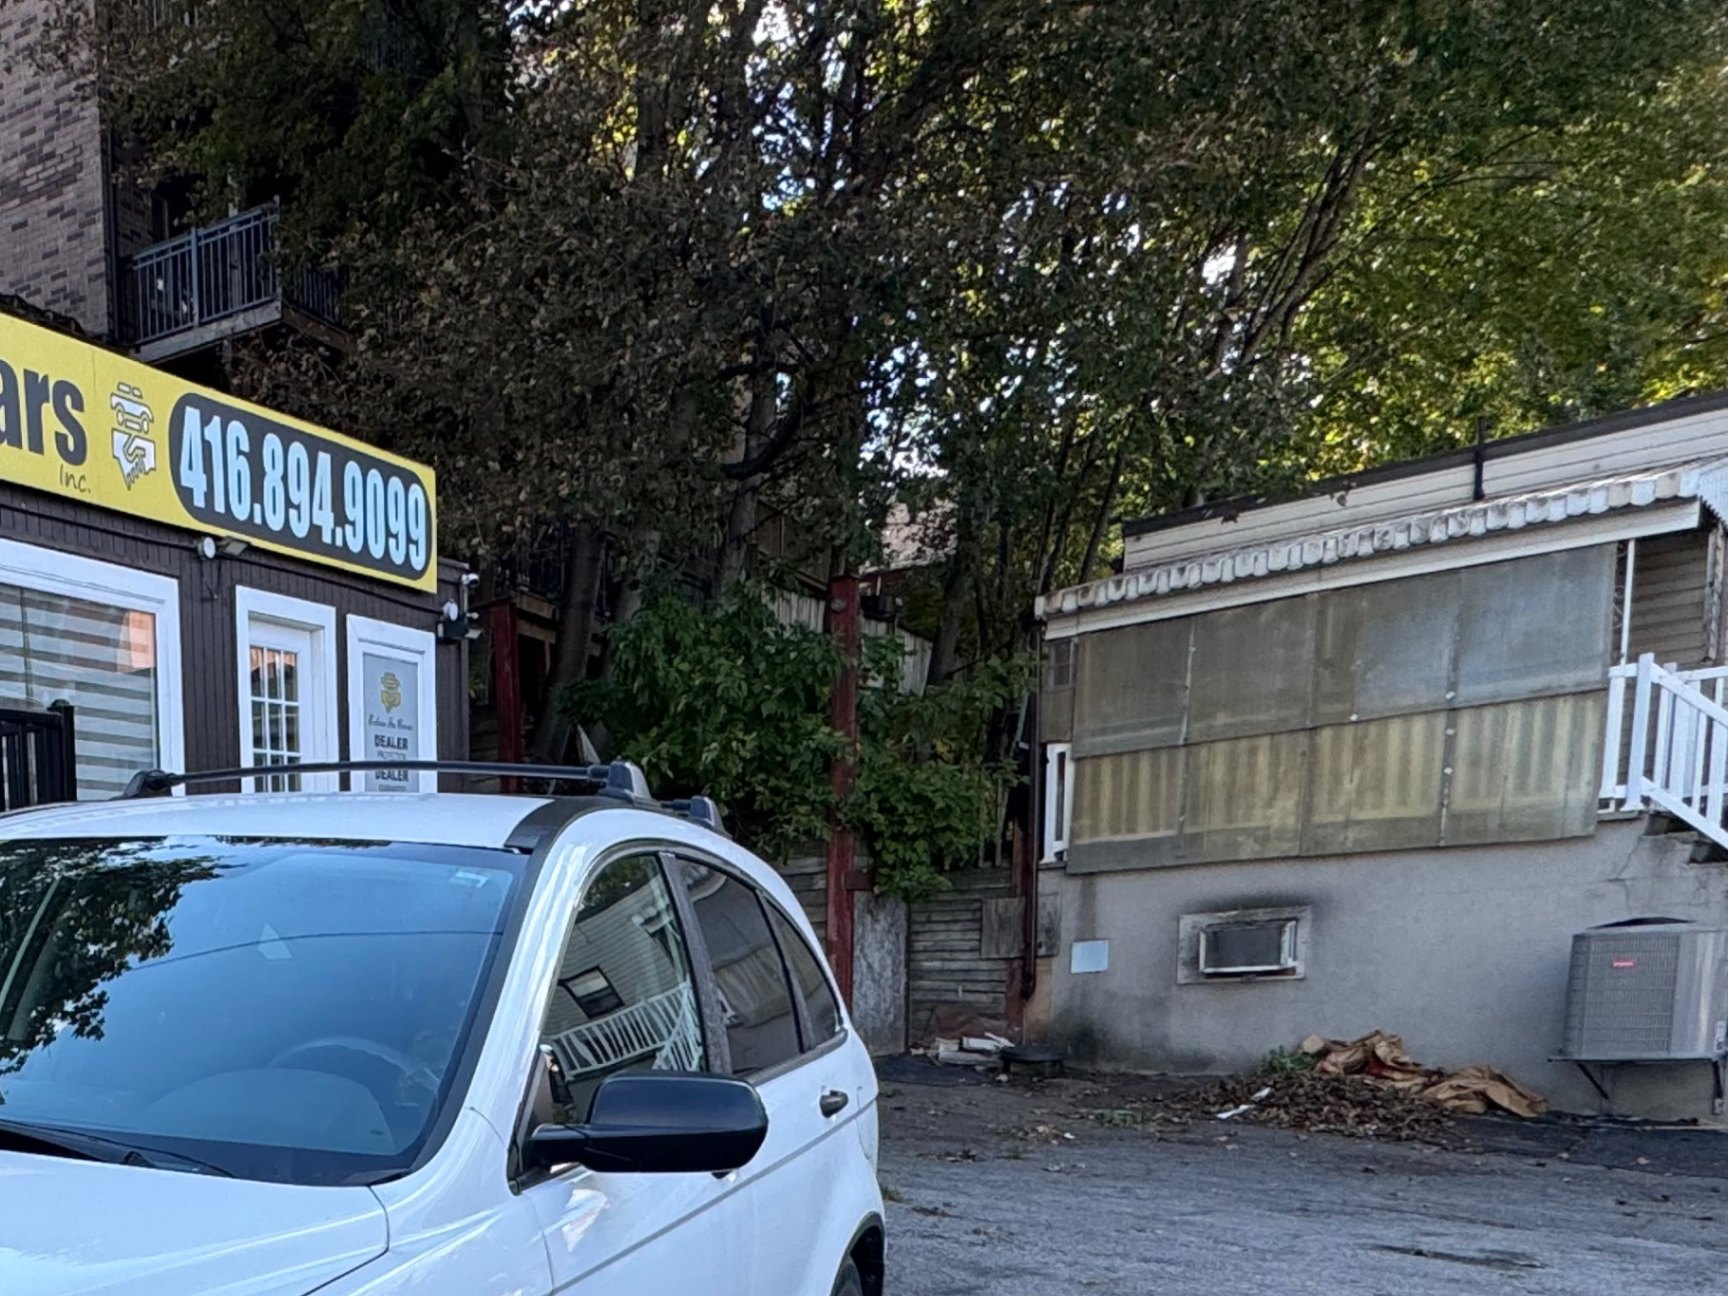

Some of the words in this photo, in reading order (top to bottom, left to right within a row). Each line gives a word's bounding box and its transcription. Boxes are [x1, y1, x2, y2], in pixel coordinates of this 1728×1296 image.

[59, 463, 92, 494] Inc.
[180, 405, 427, 572] 416.894.9099
[374, 734, 409, 751] DEALER
